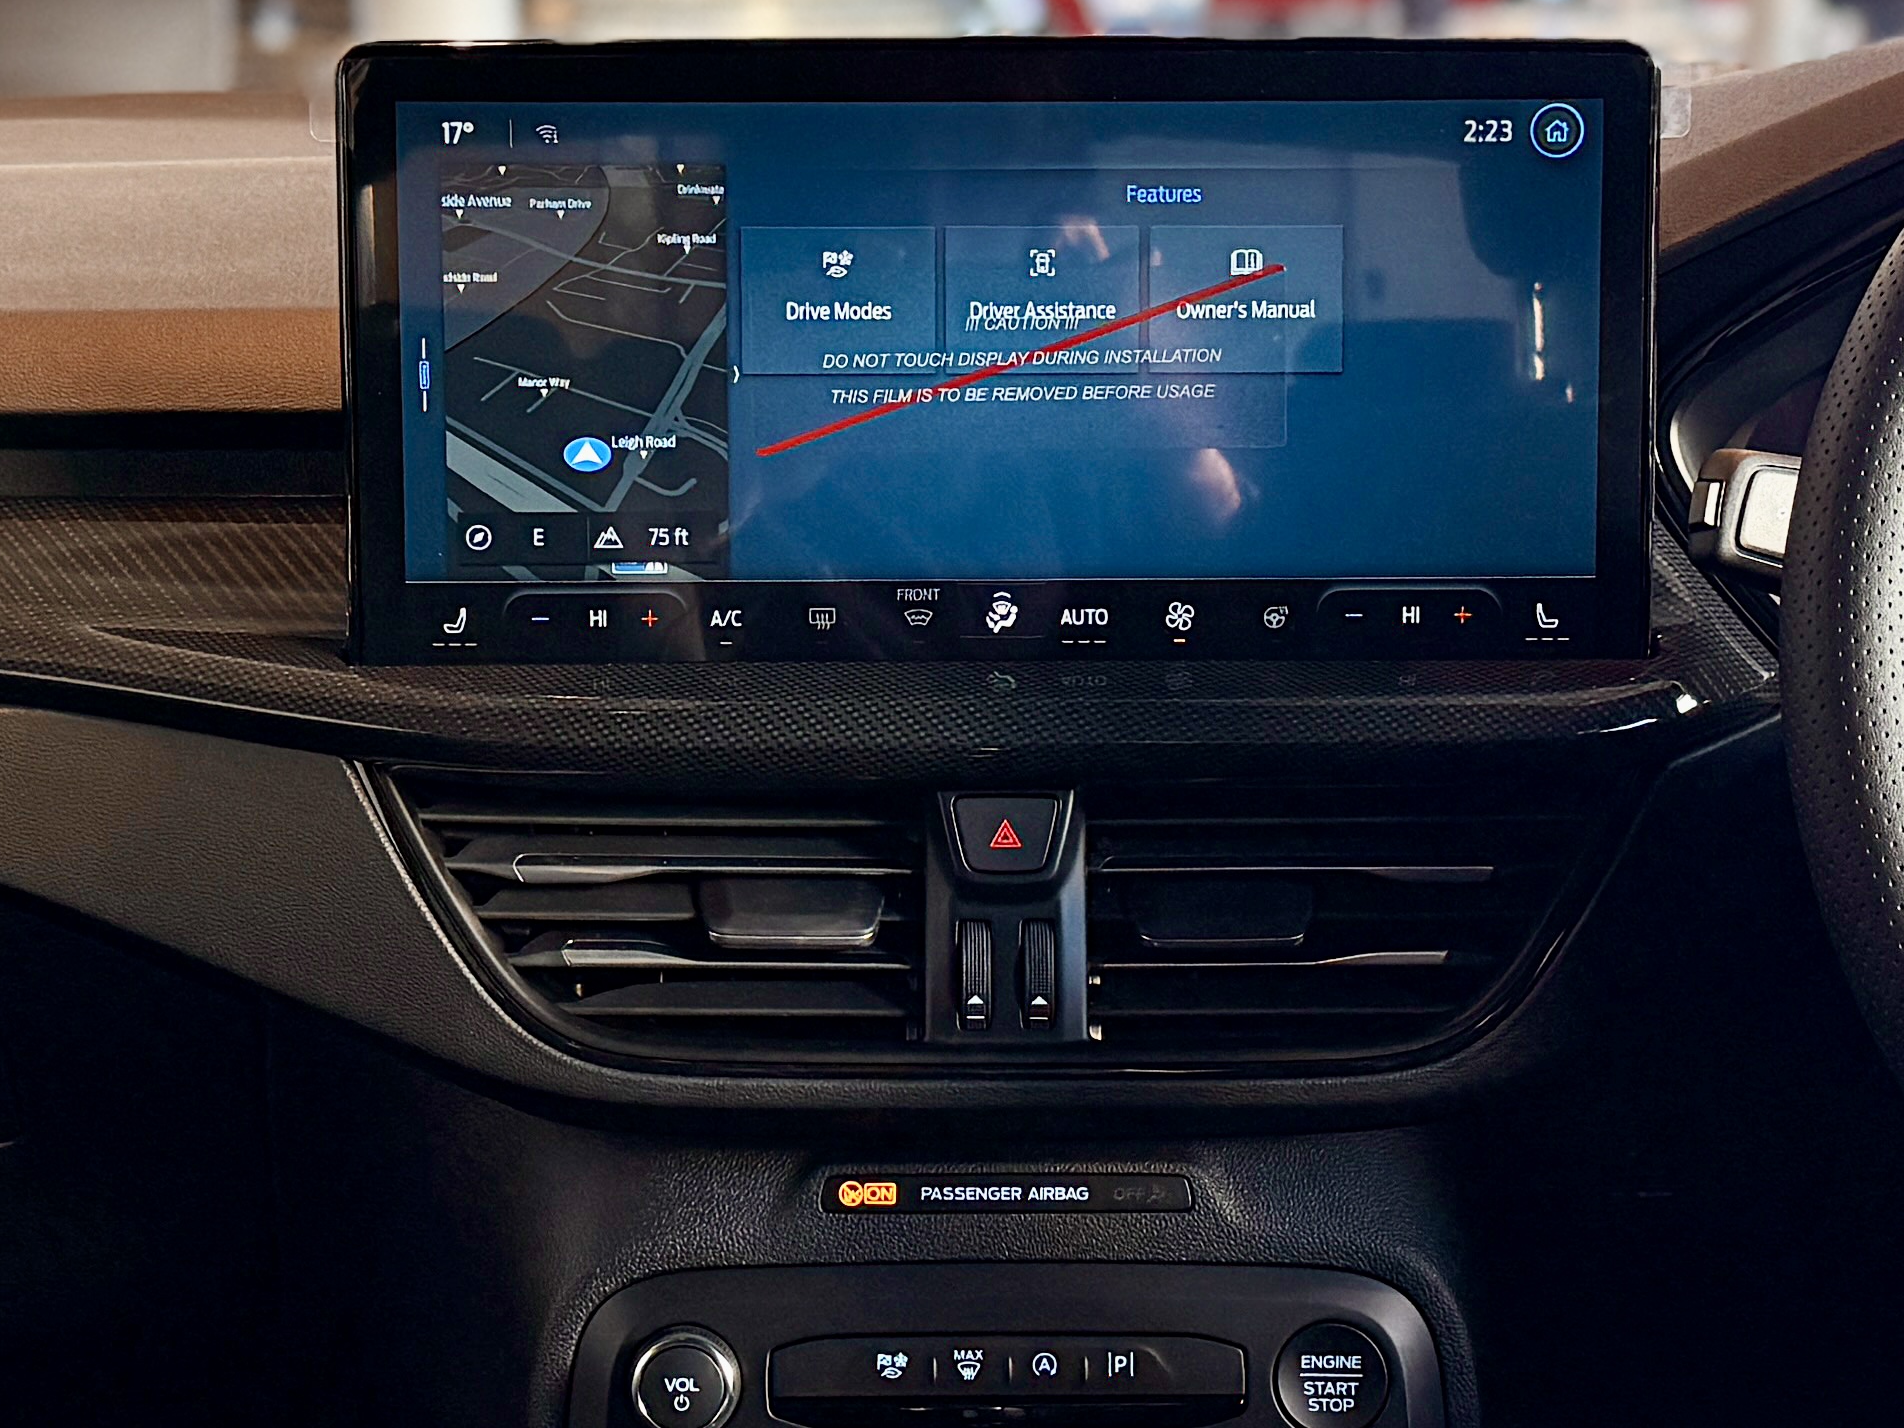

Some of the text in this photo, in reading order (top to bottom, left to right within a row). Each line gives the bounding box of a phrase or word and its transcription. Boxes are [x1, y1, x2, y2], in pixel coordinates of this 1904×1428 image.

[441, 121, 474, 145] 17°
[1463, 120, 1513, 143] 2:23
[467, 193, 512, 208] Avenue
[1126, 185, 1202, 204] Features
[567, 198, 592, 209] Drive
[692, 233, 717, 244] Road
[786, 301, 892, 320] Drive Modes
[970, 300, 1117, 320] Driver Assistance
[1176, 299, 1316, 320] Owner's Manual
[985, 316, 1060, 331] CAUTION
[822, 348, 1223, 369] DO NOT TOUCH DISPLAY DURING INSTALLATION
[831, 383, 1216, 404] THIS FILM IS TO BE REMOVED BEFORE USAGE
[612, 435, 677, 451] Leigh Road
[532, 528, 545, 547] E
[648, 528, 689, 547] 75 ft
[896, 588, 941, 602] FRONT
[589, 610, 608, 628] HI
[710, 610, 742, 628] A/C
[1061, 608, 1109, 626] AUTO
[1401, 606, 1421, 624] HI
[867, 1187, 894, 1201] ON
[920, 1186, 1089, 1201] PASSENGER AIRBAG
[1113, 1187, 1144, 1201] OFF
[953, 1349, 984, 1361] MAX
[1300, 1355, 1362, 1369] ENGINE
[664, 1377, 700, 1393] VOL
[1303, 1381, 1360, 1396] START
[1308, 1397, 1356, 1413] STOP
